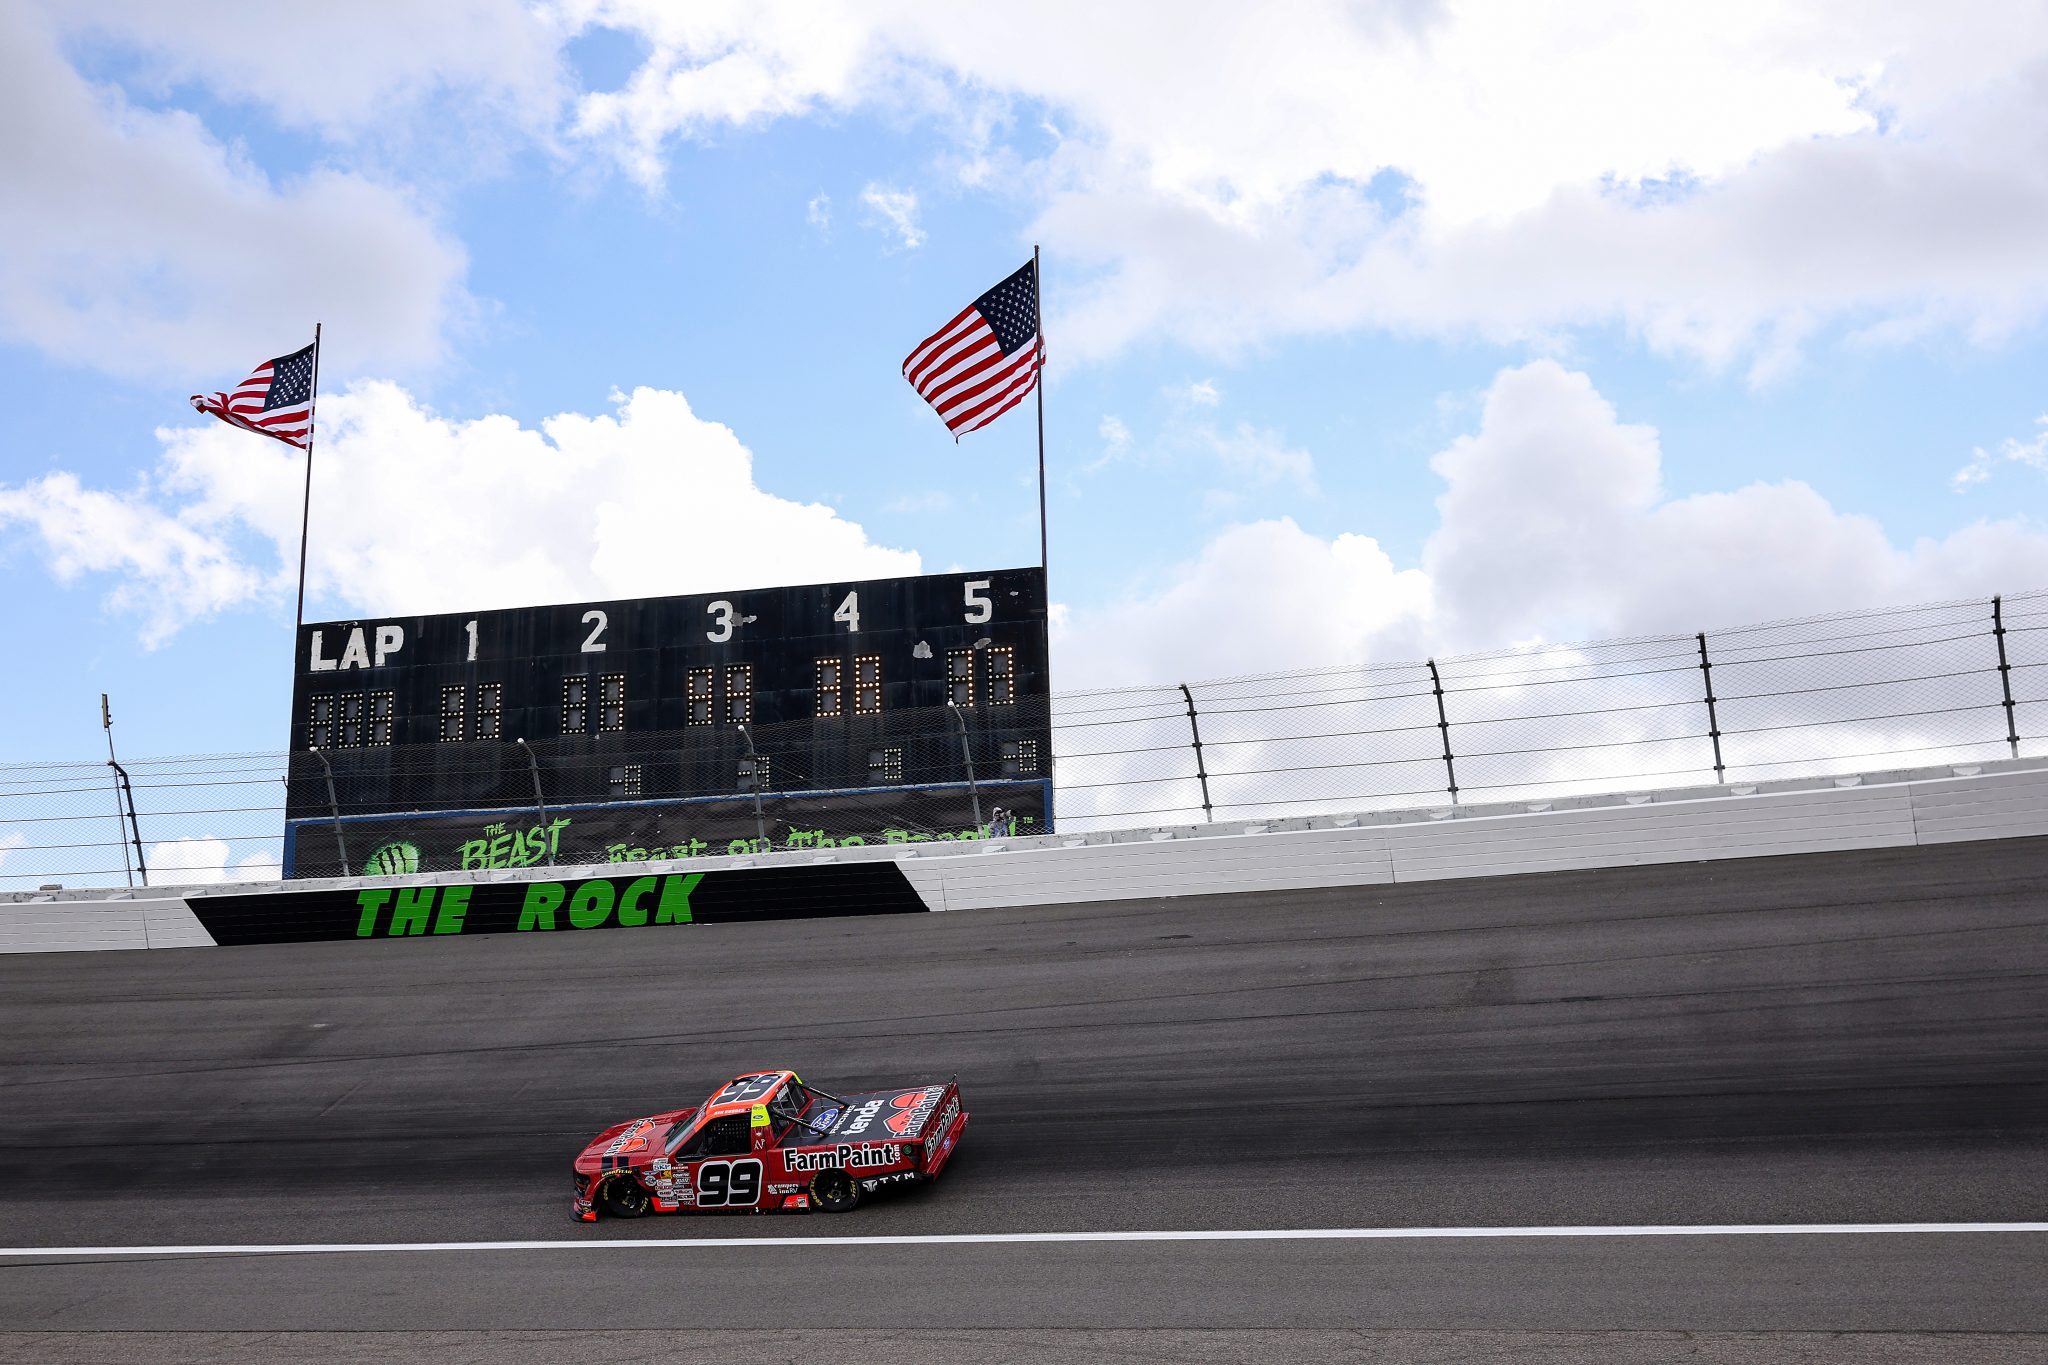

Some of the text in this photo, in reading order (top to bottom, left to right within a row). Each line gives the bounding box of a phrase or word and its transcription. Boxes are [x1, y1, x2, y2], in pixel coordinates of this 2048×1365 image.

[310, 580, 993, 671] LAP 1 2 3 4 5
[452, 817, 573, 871] BEAST
[483, 821, 507, 837] THE
[356, 873, 706, 938] THE ROCK
[830, 1104, 856, 1135] RACING
[841, 1099, 885, 1136] tenda
[783, 1142, 895, 1173] FarmPaint
[696, 1157, 764, 1208] 99
[879, 1172, 915, 1184] TYM
